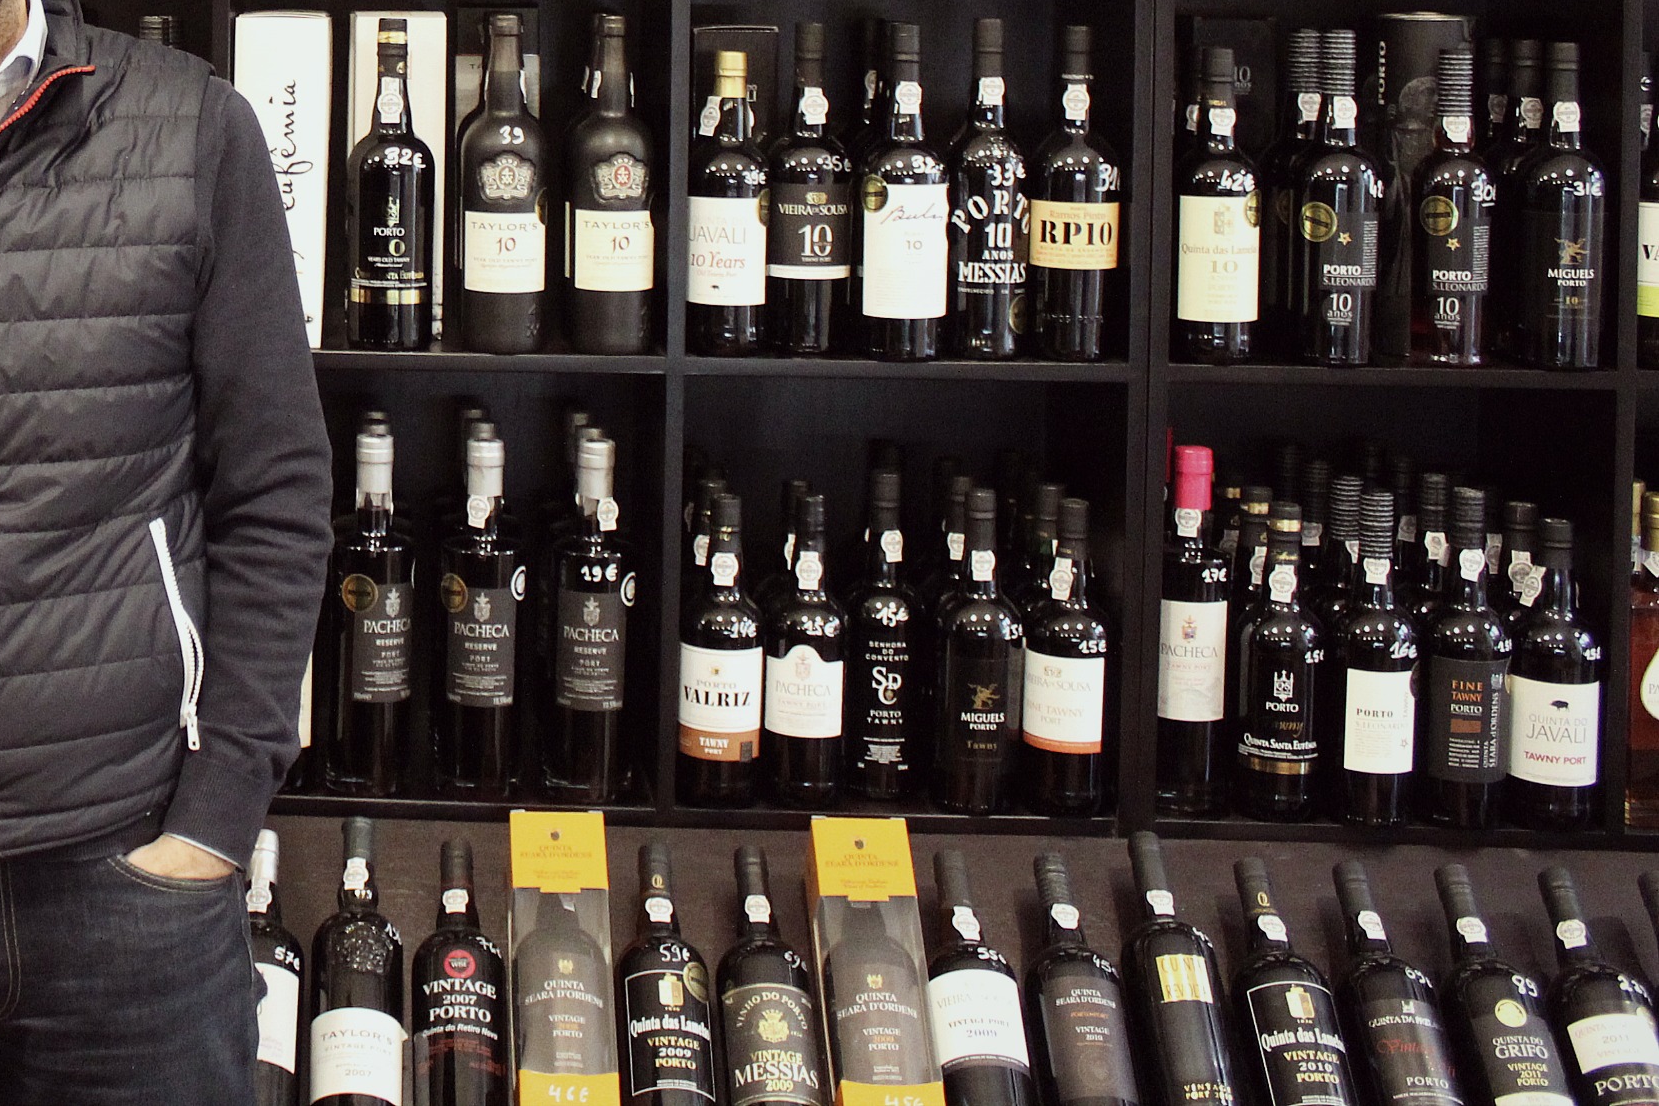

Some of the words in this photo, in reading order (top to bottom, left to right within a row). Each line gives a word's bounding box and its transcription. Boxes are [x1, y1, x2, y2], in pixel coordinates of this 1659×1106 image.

[499, 125, 525, 145] 39
[778, 202, 812, 216] VIEIRA
[819, 202, 848, 215] SOUSA
[1049, 209, 1080, 219] Ramos
[1082, 209, 1107, 219] Pinto
[471, 221, 539, 232] TAYLOR'S
[1041, 219, 1113, 246] RP10
[797, 224, 834, 257] 10
[985, 222, 1012, 248] 10
[495, 236, 517, 255] 10
[611, 235, 630, 252] 10
[957, 262, 1027, 285] MESSIAS
[1323, 265, 1362, 276] PORTO
[1432, 269, 1473, 282] PORTO
[1547, 268, 1595, 281] MIGUELS
[1330, 293, 1352, 313] 10
[1436, 296, 1460, 316] 10
[580, 565, 618, 582] 19€
[454, 622, 510, 639] PACHECA
[563, 625, 619, 643] PACHECA
[868, 641, 907, 649] SENHORA
[865, 653, 909, 662] CONVENTO
[775, 681, 832, 697] PACHECA
[1451, 679, 1484, 692] FINE
[684, 686, 752, 707] VALRIZ
[1451, 691, 1484, 703] TAWNY
[1266, 701, 1300, 713] PORTO
[1450, 704, 1483, 715] PORTO
[960, 712, 1005, 724] MIGUELS
[1529, 714, 1571, 727] QUINTA
[1573, 716, 1588, 726] DO
[1525, 725, 1588, 745] JAVALI
[698, 737, 730, 749] TAWNY
[1524, 750, 1561, 766] TAWNY
[1563, 755, 1587, 767] PORT
[659, 944, 691, 964] 59€
[423, 978, 497, 1000] VINTAGE
[1512, 974, 1538, 997] 89
[442, 994, 476, 1006] 2007
[855, 992, 897, 1003] QUINTA
[429, 1007, 491, 1023] PORTO
[320, 1029, 392, 1046] TAYLOR'S
[1075, 1026, 1110, 1036] VINTAGE
[647, 1038, 700, 1051] VINTAGE
[1492, 1036, 1526, 1046] QUINTA
[1527, 1036, 1544, 1046] DO
[658, 1046, 691, 1058] 2009
[749, 1049, 803, 1066] VINTAGE
[1283, 1050, 1339, 1064] VINTAGE
[1495, 1044, 1549, 1060] GRIFO
[655, 1058, 696, 1070] PORTO
[1298, 1061, 1333, 1072] 2010
[734, 1060, 819, 1091] MESSIAS
[1296, 1073, 1339, 1084] PORTO
[1406, 1075, 1449, 1089] PORTO
[1516, 1077, 1549, 1087] PORTO
[765, 1079, 794, 1092] 2009
